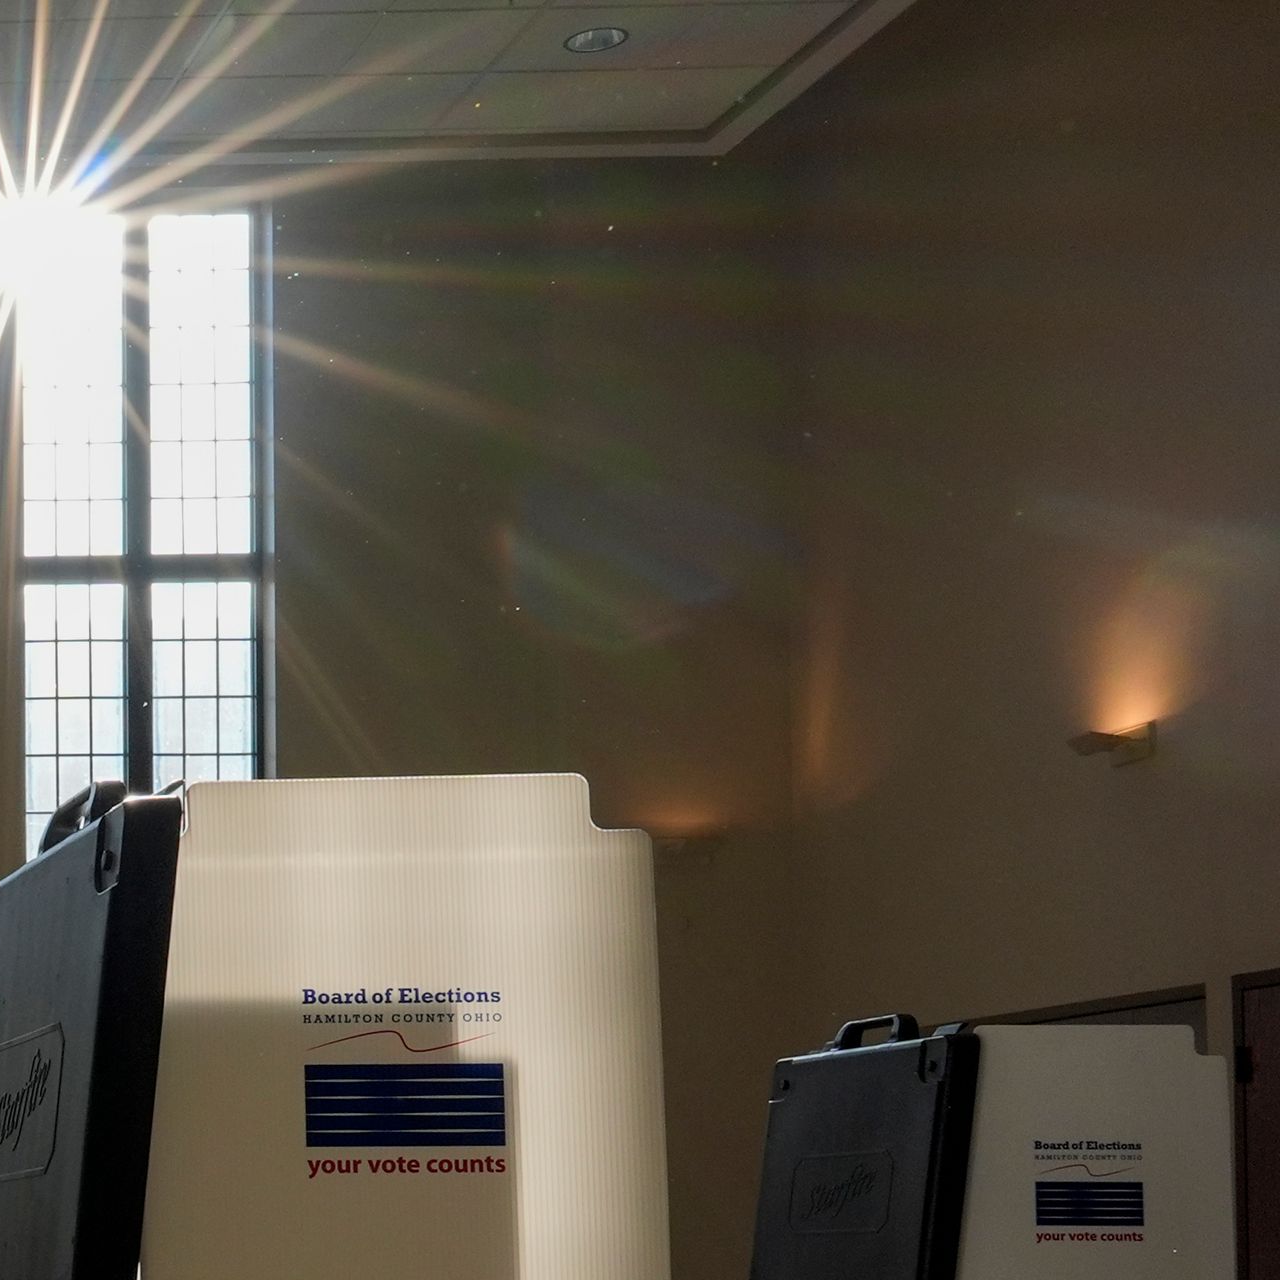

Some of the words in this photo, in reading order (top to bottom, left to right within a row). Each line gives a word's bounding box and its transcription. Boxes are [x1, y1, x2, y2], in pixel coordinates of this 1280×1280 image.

[302, 988, 368, 1004] Board
[372, 988, 394, 1004] of
[398, 988, 501, 1003] Elections
[303, 1014, 384, 1024] HAMILTON
[391, 1013, 455, 1023] COUNTY
[462, 1013, 502, 1022] OHIO
[1034, 1141, 1069, 1150] Board
[1071, 1141, 1084, 1150] of
[1086, 1141, 1142, 1150] Elections
[307, 1158, 362, 1179] your
[368, 1156, 420, 1174] vote
[426, 1156, 506, 1173] counts
[1036, 1232, 1066, 1243] your
[1068, 1232, 1097, 1242] vote
[1100, 1232, 1144, 1242] counts
